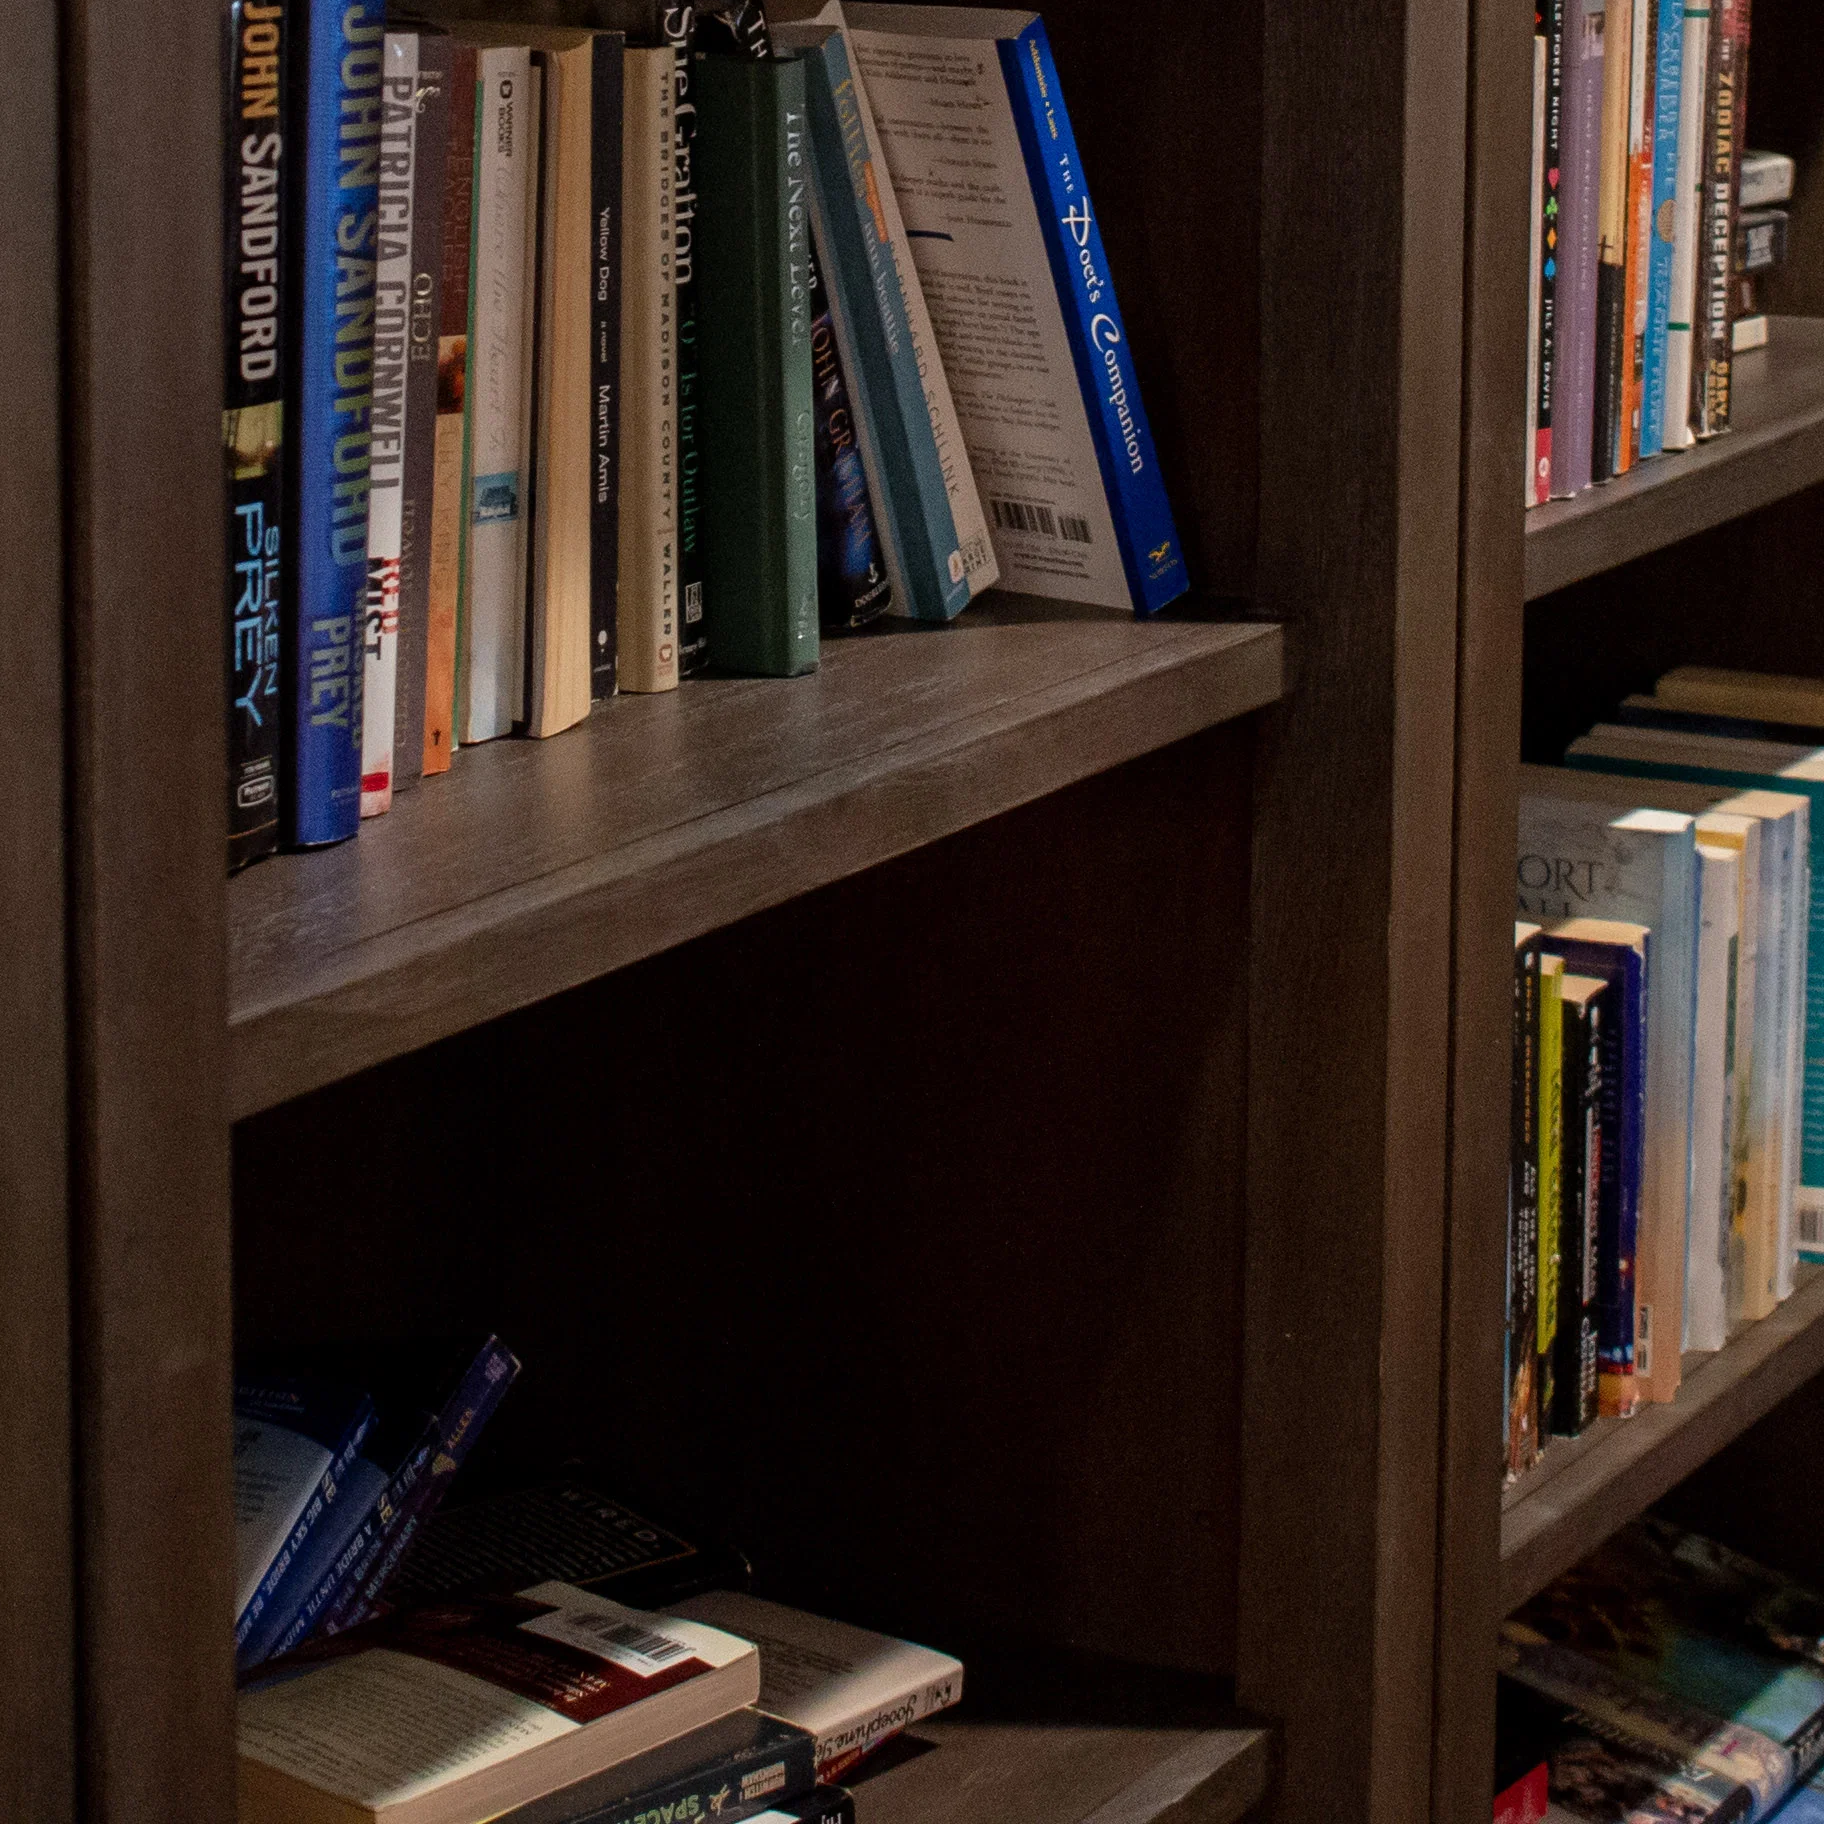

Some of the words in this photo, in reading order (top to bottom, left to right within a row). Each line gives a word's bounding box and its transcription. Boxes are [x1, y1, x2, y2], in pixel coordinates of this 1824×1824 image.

[238, 0, 282, 120] JOHN
[339, 3, 384, 190] JOHN
[663, 6, 696, 95] Sue
[1713, 73, 1731, 173] ZODIAC
[376, 76, 413, 260] PATRICIA
[675, 104, 696, 286] Grafton
[1058, 153, 1076, 194] THE
[238, 133, 283, 382] SANDFORD
[410, 273, 434, 362] ECHO
[595, 267, 610, 302] Dog
[1061, 197, 1105, 304] Poet's
[1710, 183, 1728, 339] DECEPTION
[330, 211, 374, 567] SANDFORD
[369, 280, 408, 489] CORNWELL
[598, 383, 613, 447] Martin
[1091, 311, 1146, 474] Companion
[233, 500, 264, 730] PREY
[262, 526, 280, 696] SILKEN
[310, 615, 351, 730] PREY
